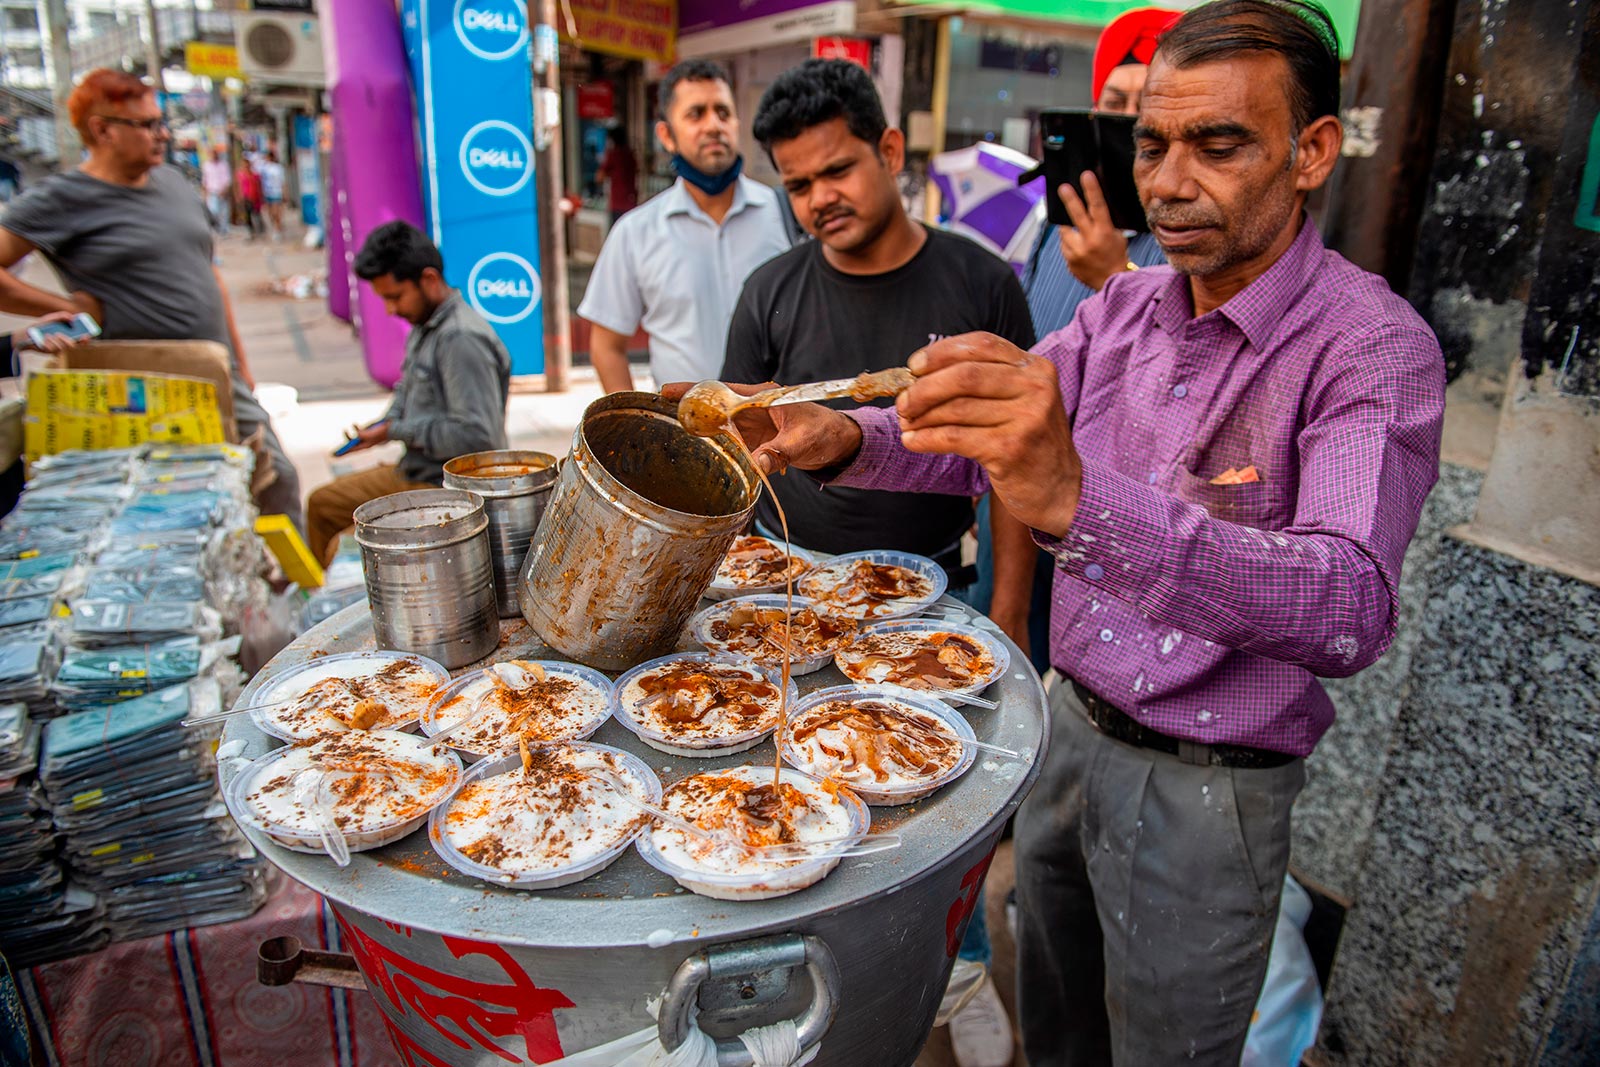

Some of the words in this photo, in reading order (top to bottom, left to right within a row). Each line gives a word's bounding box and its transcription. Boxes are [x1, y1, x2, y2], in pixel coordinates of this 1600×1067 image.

[463, 8, 519, 32] DELL
[469, 148, 523, 168] DELL
[477, 279, 531, 297] DELL
